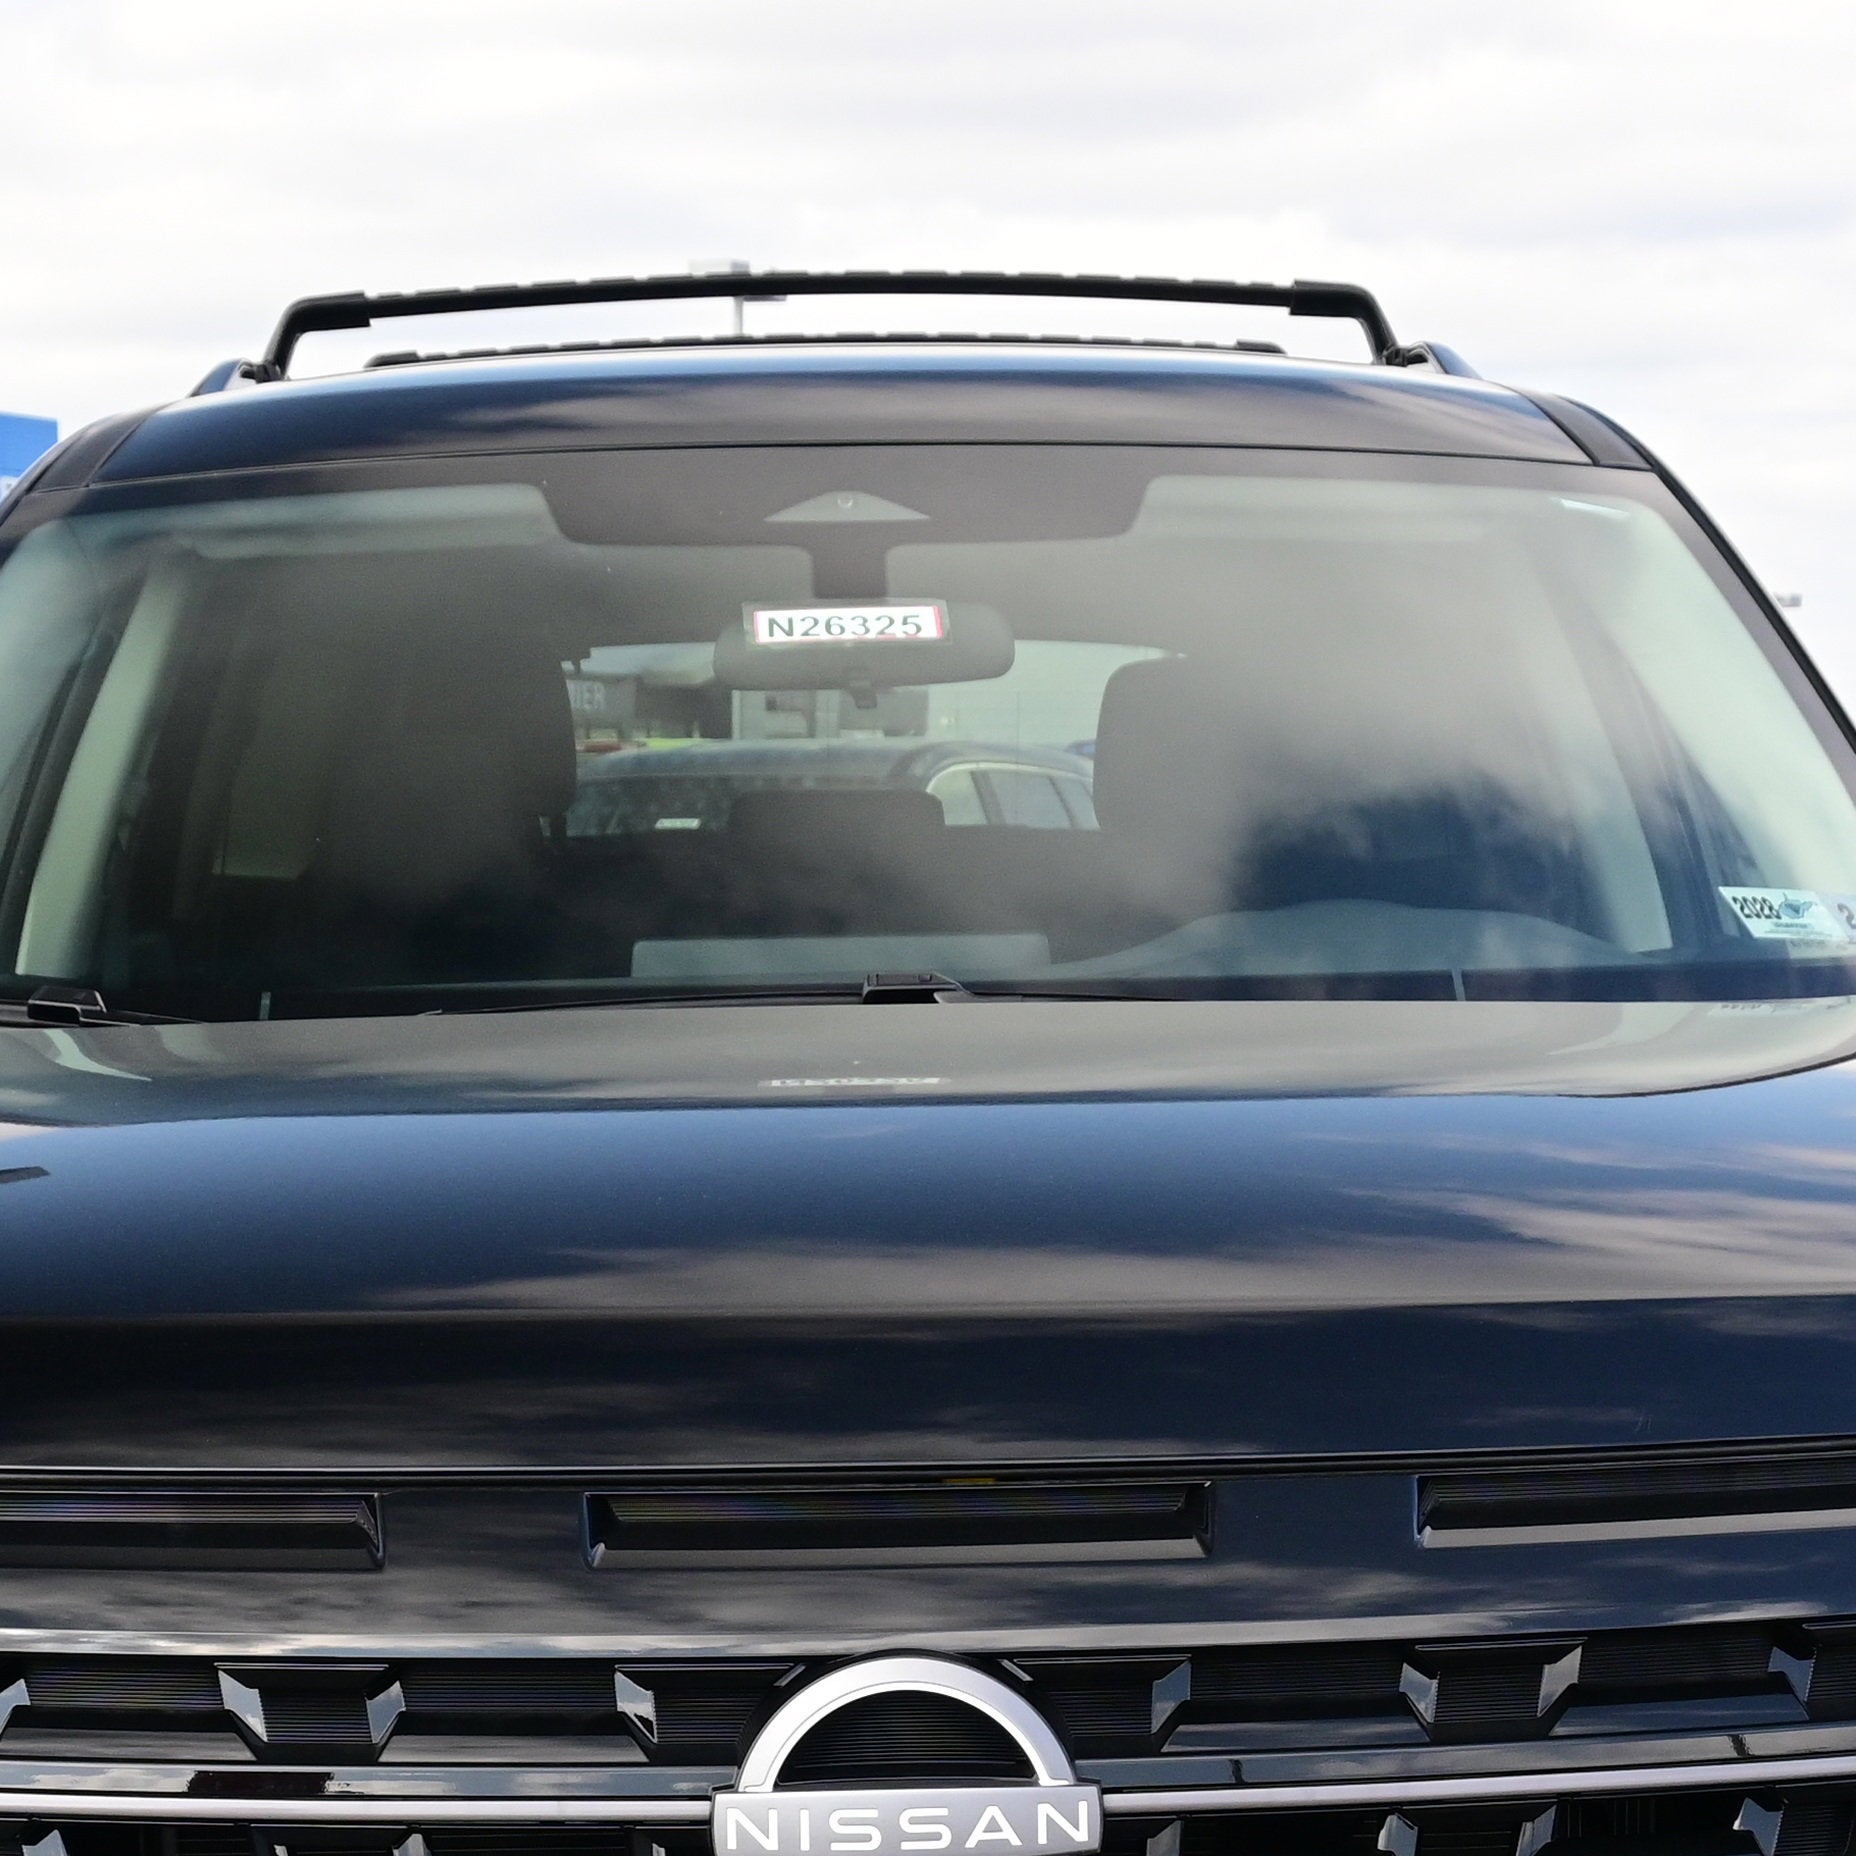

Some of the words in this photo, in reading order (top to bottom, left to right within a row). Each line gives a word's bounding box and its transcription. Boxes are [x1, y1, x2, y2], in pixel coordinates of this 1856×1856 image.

[767, 614, 922, 638] N26325
[1731, 896, 1782, 920] 2028
[726, 1800, 1088, 1852] NISSAN
